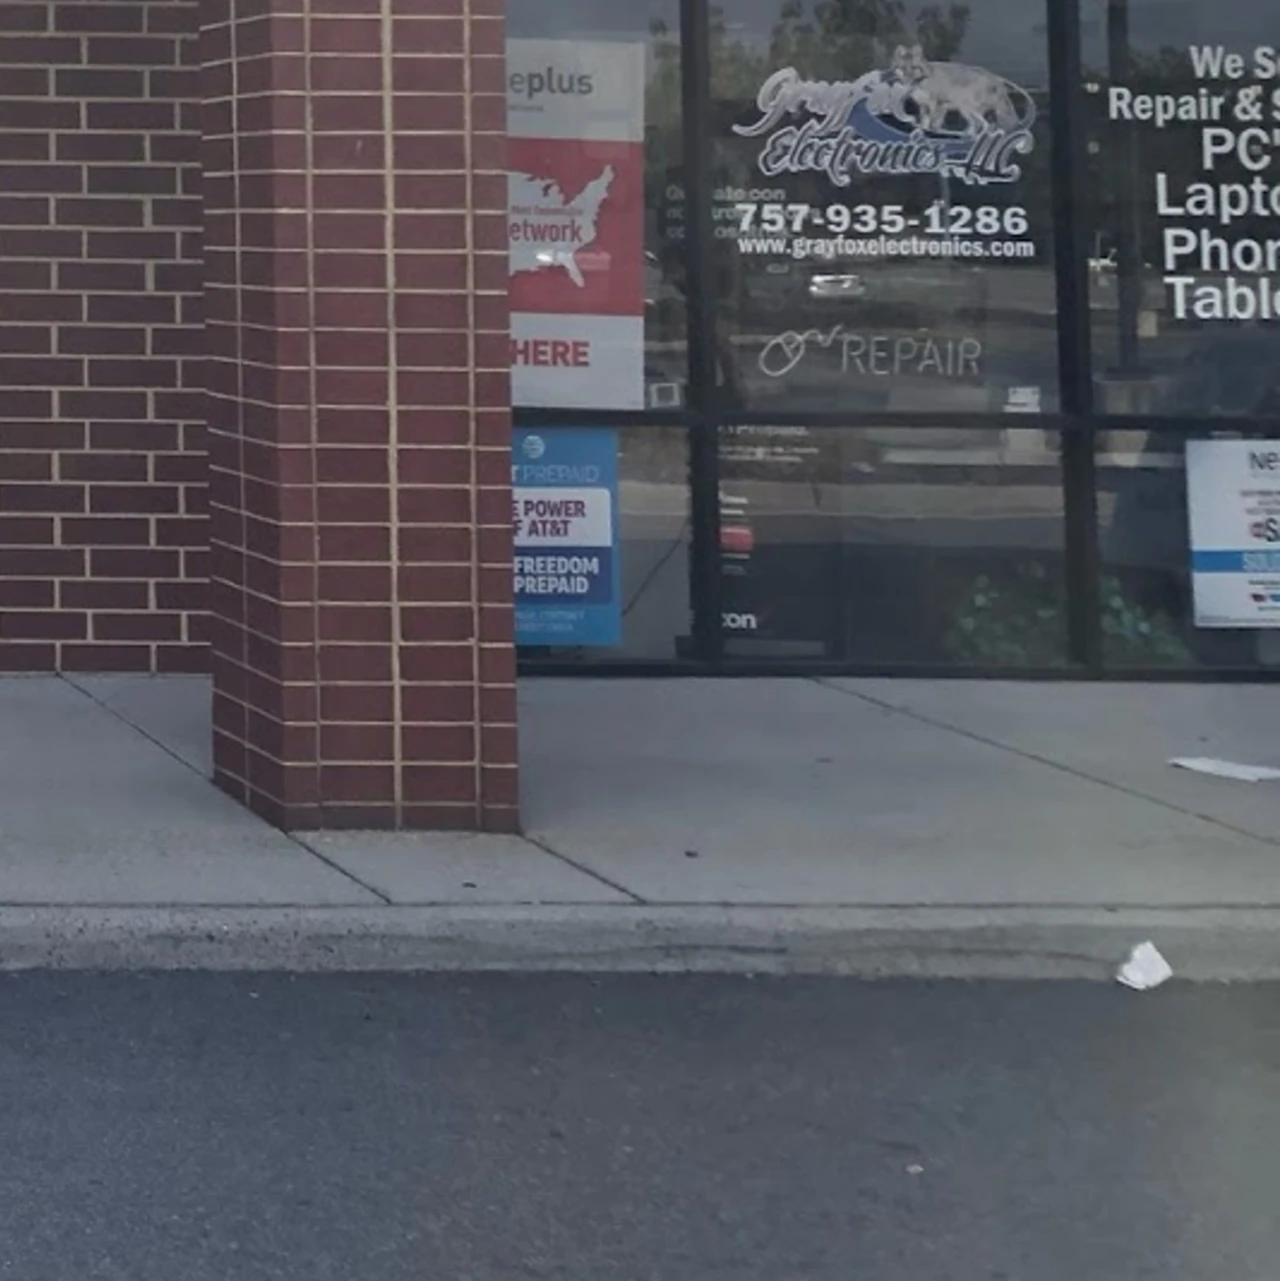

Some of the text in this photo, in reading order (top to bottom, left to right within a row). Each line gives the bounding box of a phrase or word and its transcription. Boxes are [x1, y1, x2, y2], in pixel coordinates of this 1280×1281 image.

[1190, 45, 1244, 78] We
[1109, 87, 1225, 127] Repair
[1234, 86, 1264, 120] &
[758, 120, 943, 187] Electronics
[735, 203, 1028, 235] 757-935-1286
[738, 235, 1035, 258] www.grayfoxelectronics.com
[513, 339, 590, 367] HERE
[842, 335, 981, 376] REPAIR
[523, 464, 600, 483] PREPAID
[523, 500, 586, 518] POWER
[527, 520, 571, 537] AT&T
[514, 556, 600, 575] FREEDOM
[514, 577, 590, 594] PREPAID
